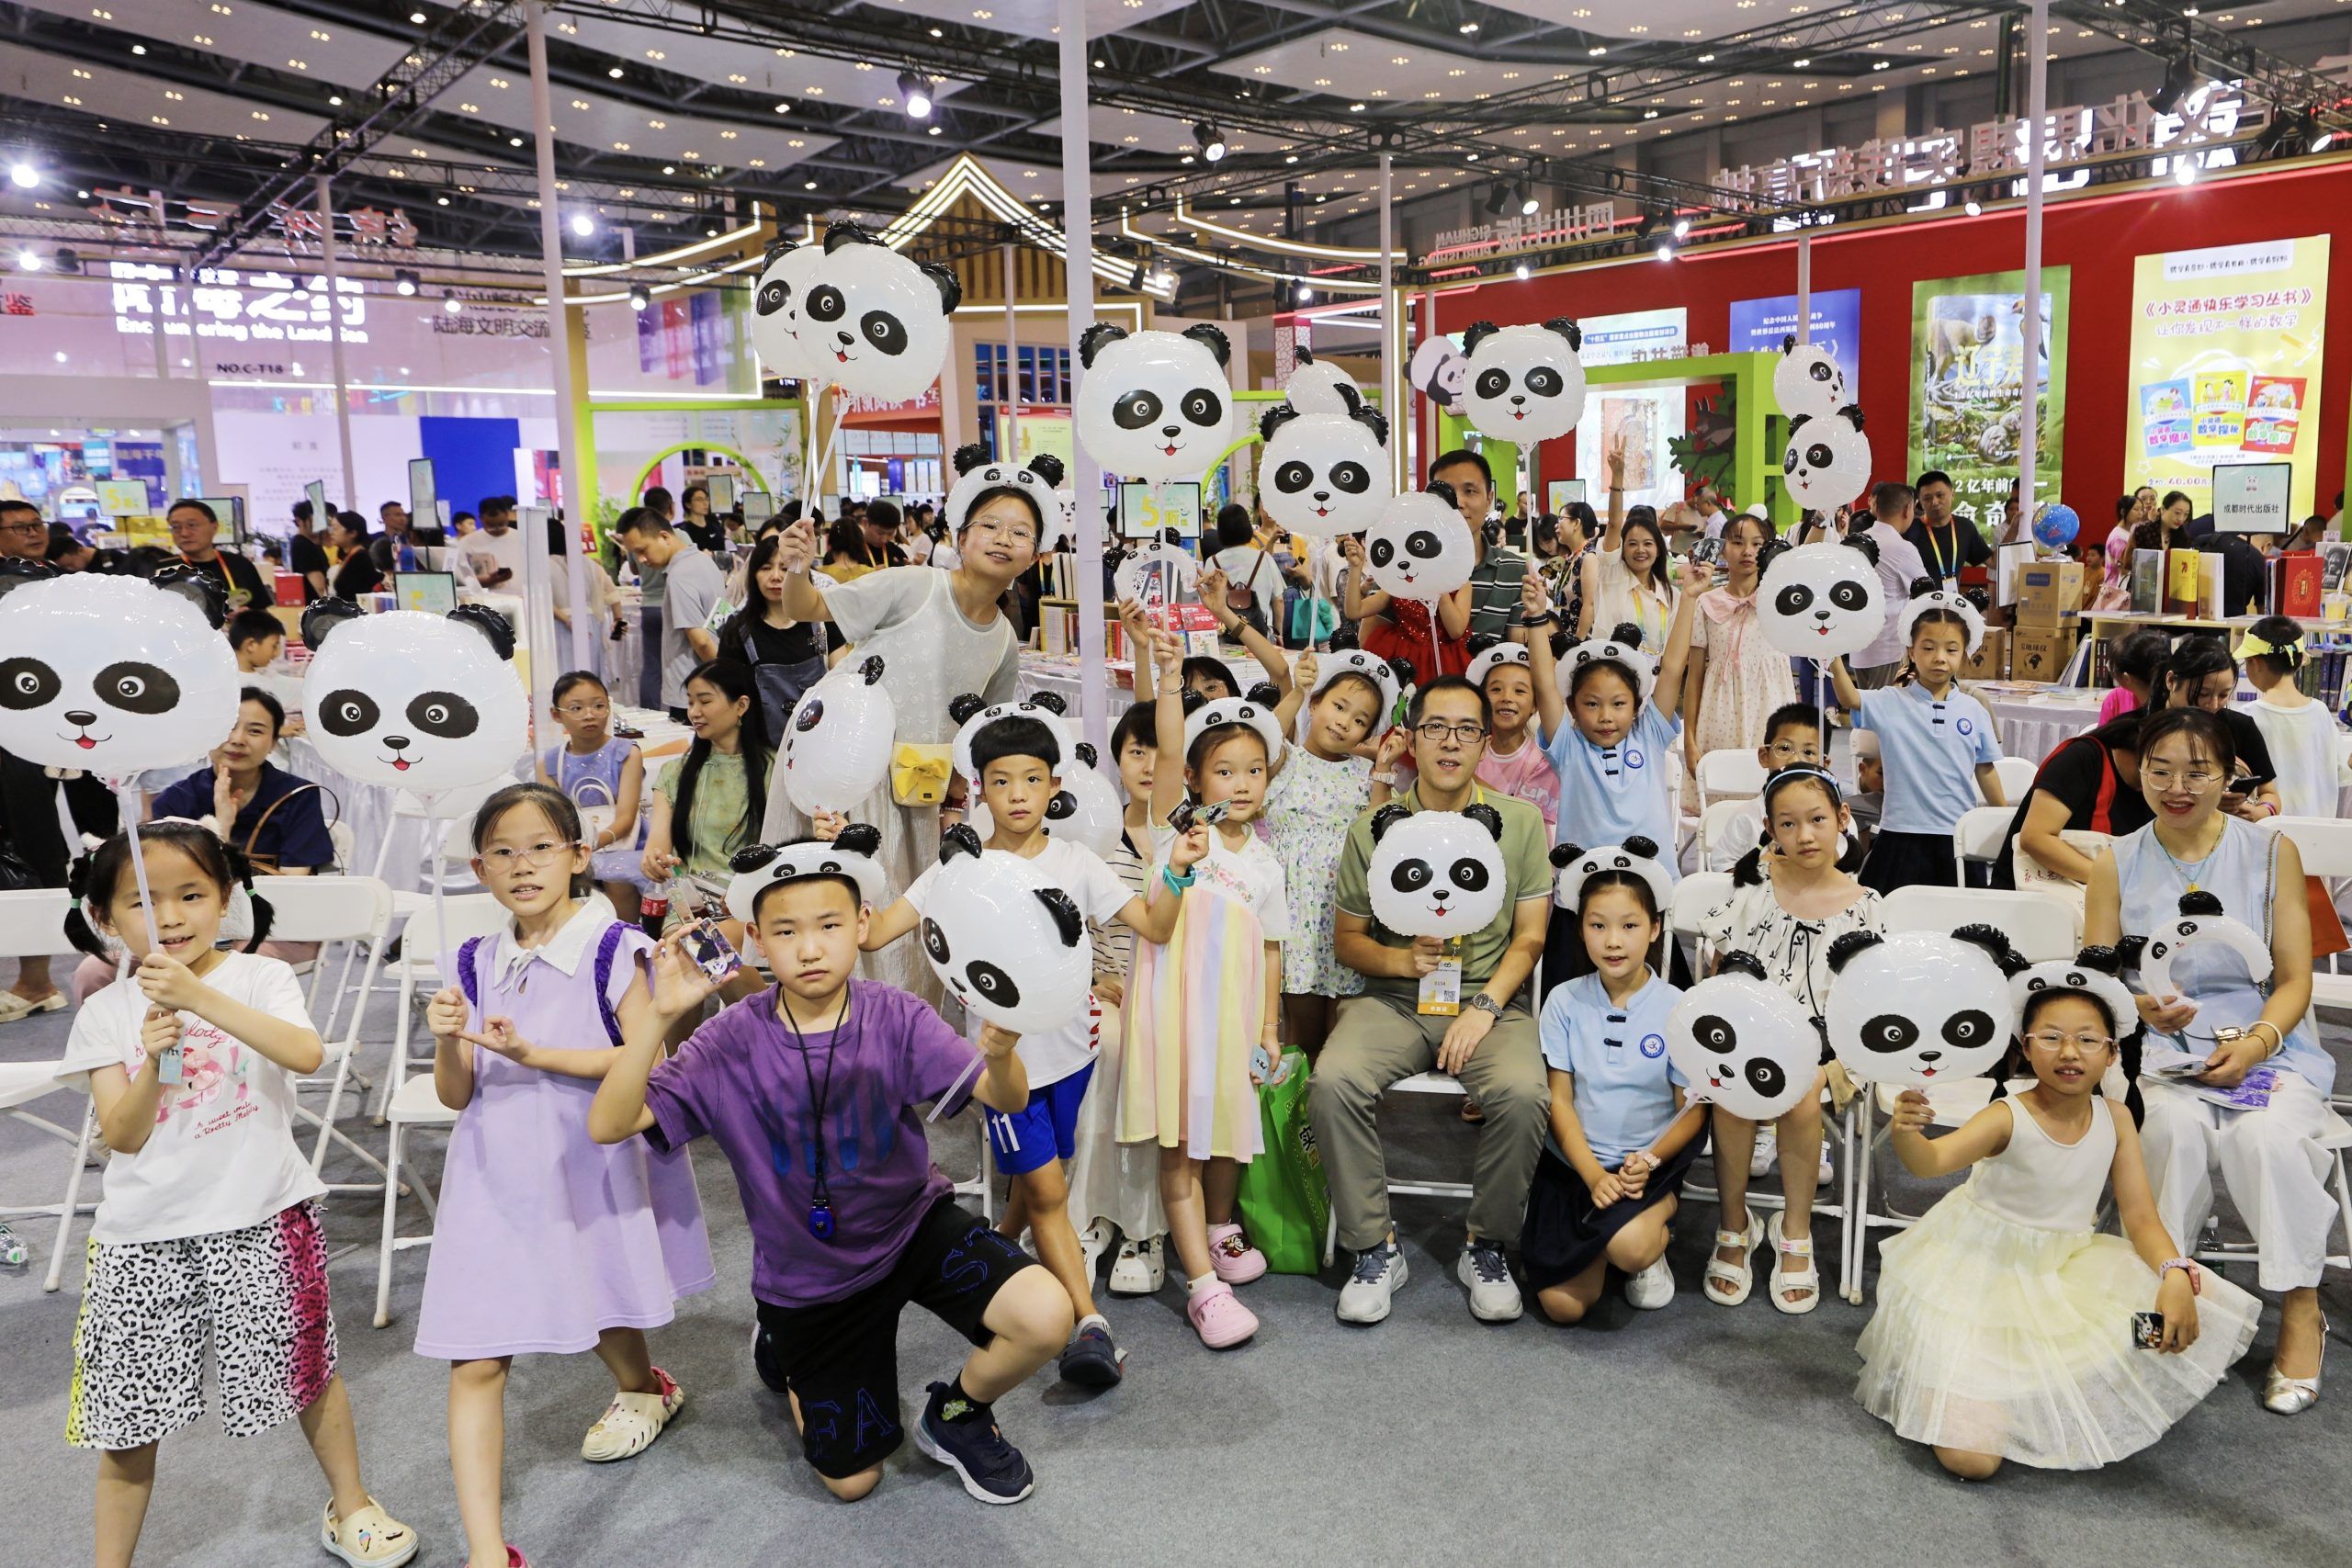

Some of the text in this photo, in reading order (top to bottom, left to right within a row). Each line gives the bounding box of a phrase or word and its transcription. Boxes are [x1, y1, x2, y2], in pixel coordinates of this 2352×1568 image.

[2146, 288, 2312, 317] 《小灵通快乐学习丛书》
[1763, 312, 1823, 325] 纪念中国人民战争
[2156, 310, 2298, 336] 让你发现不一样的数学
[2223, 503, 2279, 513] 成都时代出版社
[991, 1113, 1021, 1154] 11
